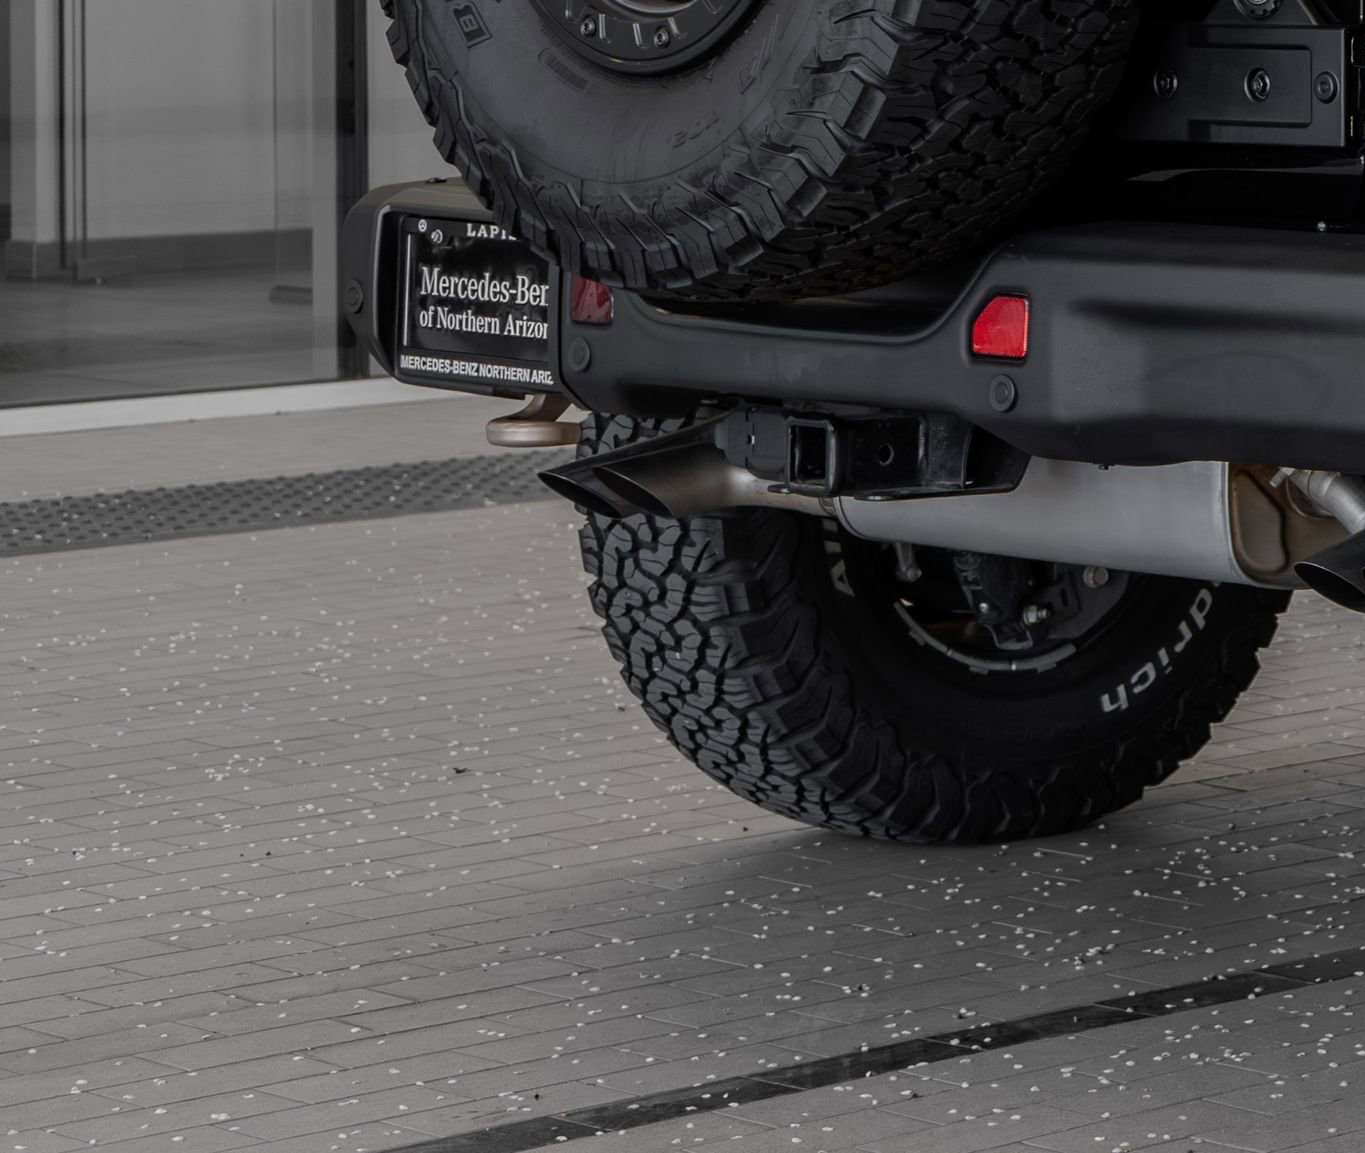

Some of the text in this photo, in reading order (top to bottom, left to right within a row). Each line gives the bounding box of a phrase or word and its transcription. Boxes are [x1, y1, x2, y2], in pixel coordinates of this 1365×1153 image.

[419, 305, 436, 328] of
[436, 306, 500, 335] Northern
[400, 354, 478, 377] MERCEDES-BENZ
[478, 362, 531, 384] NORTHERN
